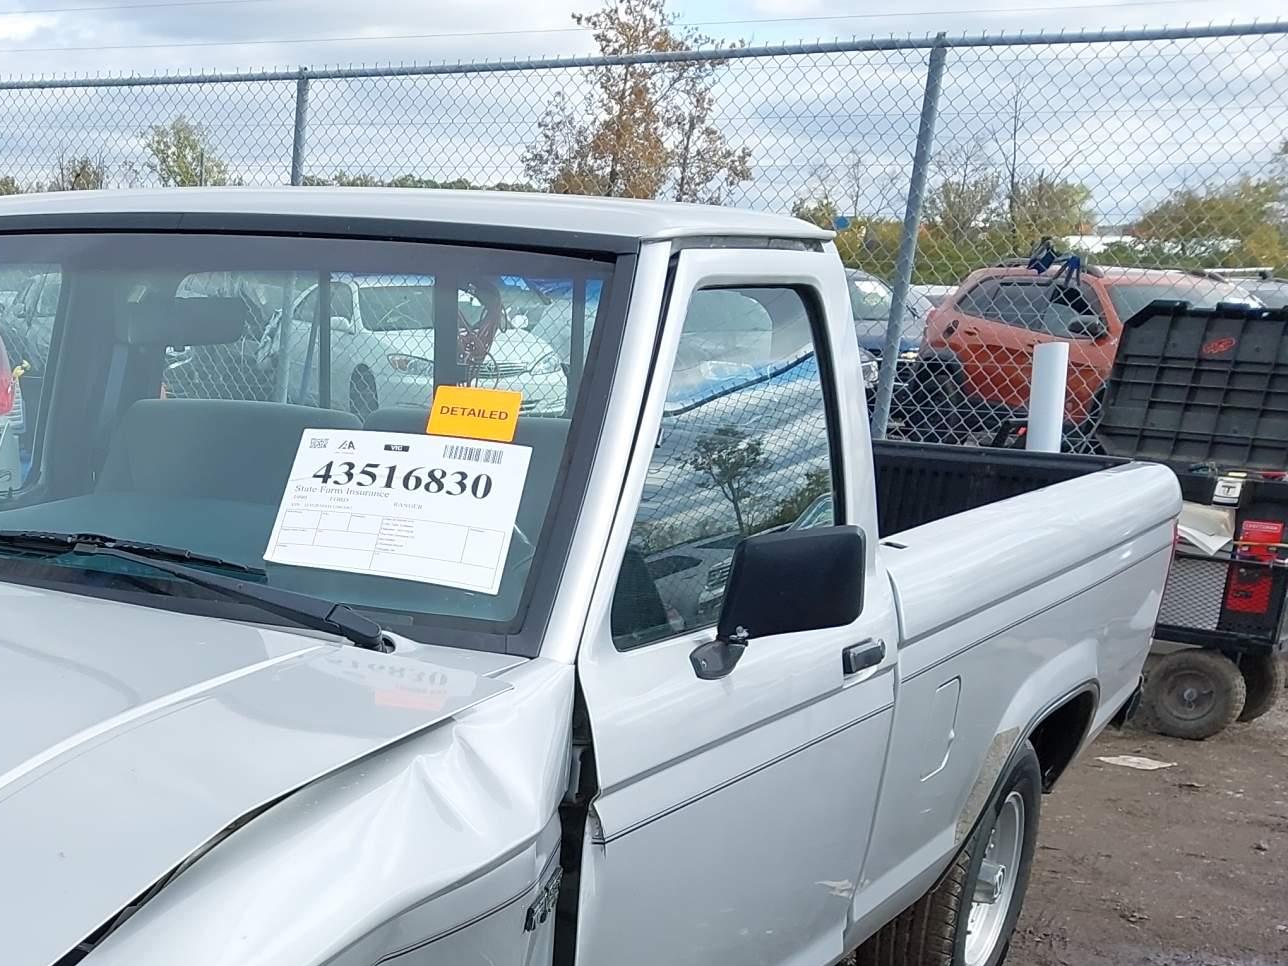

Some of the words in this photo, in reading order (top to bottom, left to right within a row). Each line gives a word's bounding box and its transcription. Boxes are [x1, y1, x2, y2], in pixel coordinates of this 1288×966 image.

[439, 405, 509, 421] DETAILED
[312, 460, 493, 500] 43516830
[294, 484, 318, 493] State
[319, 486, 344, 495] Farm
[346, 487, 390, 498] Insurance
